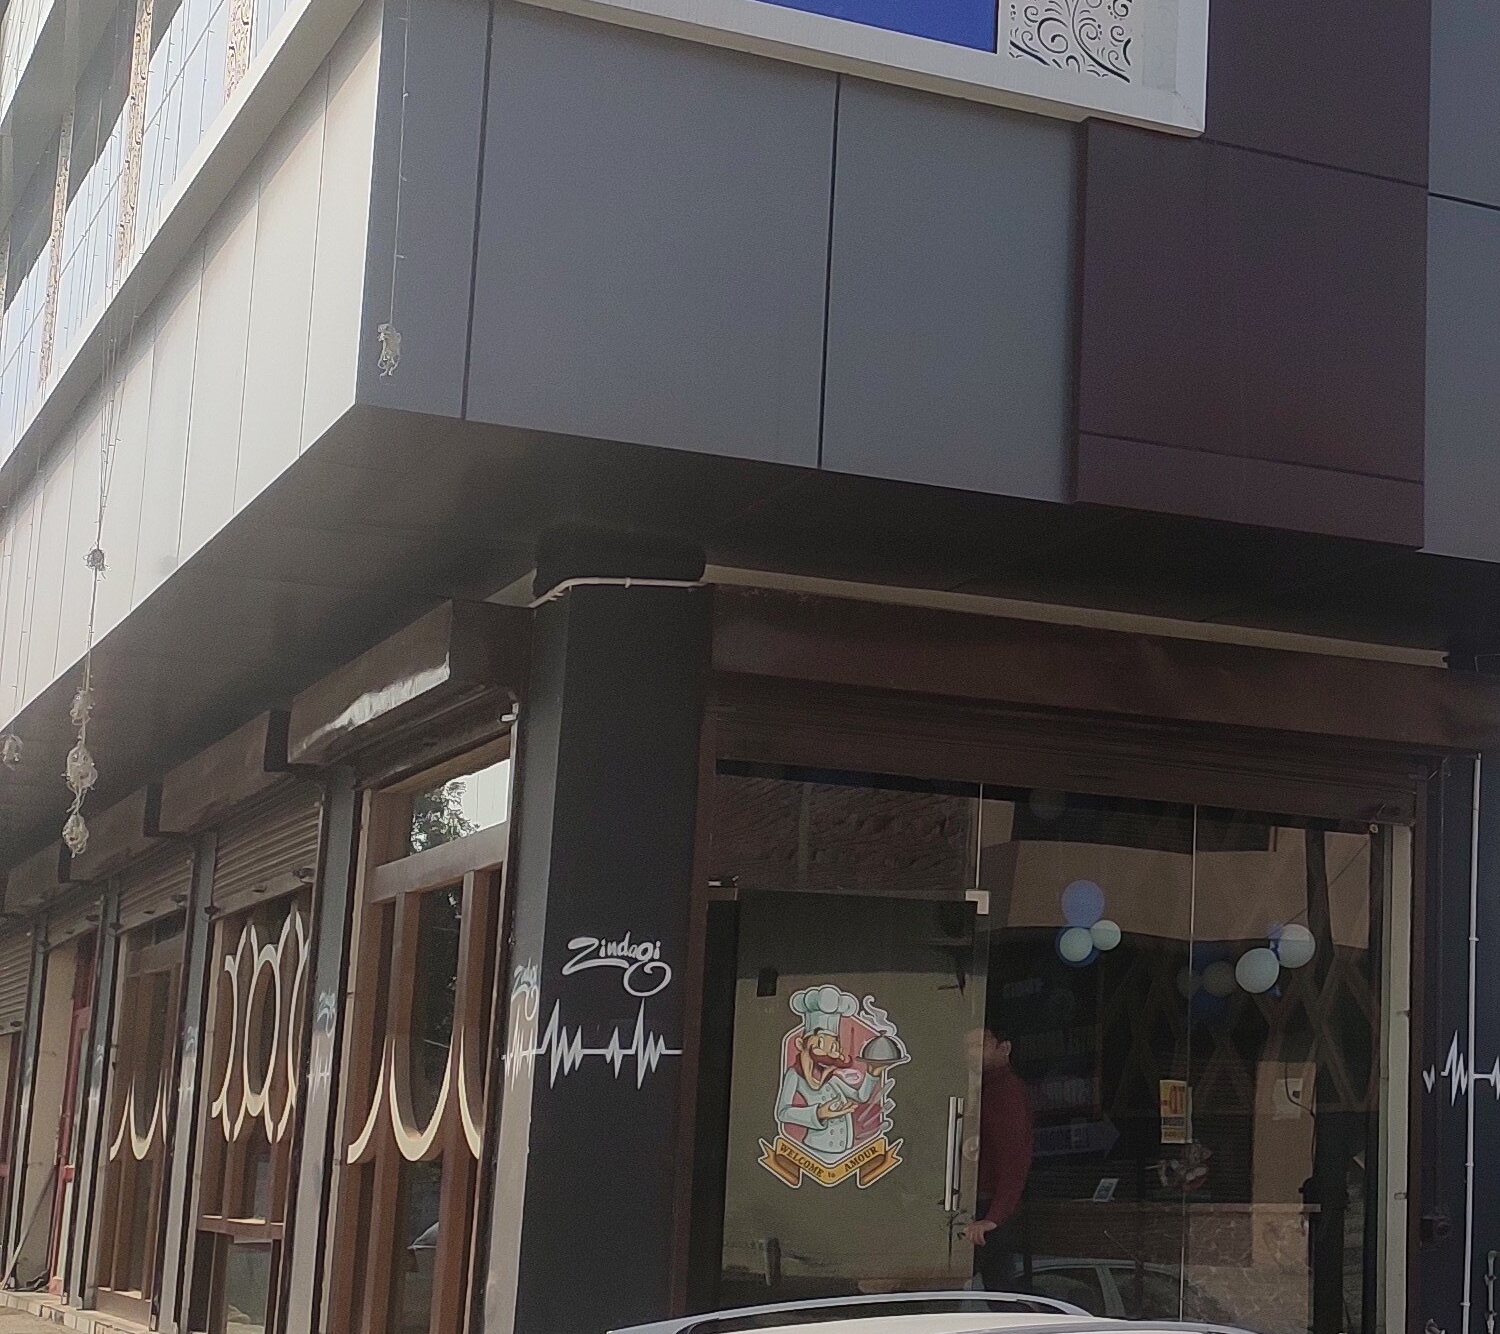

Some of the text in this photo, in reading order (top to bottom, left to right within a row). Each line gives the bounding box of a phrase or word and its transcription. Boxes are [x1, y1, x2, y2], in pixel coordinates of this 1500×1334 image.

[561, 930, 672, 997] Zindagi
[780, 1142, 825, 1178] WELCOME
[843, 1145, 879, 1173] AMOUR
